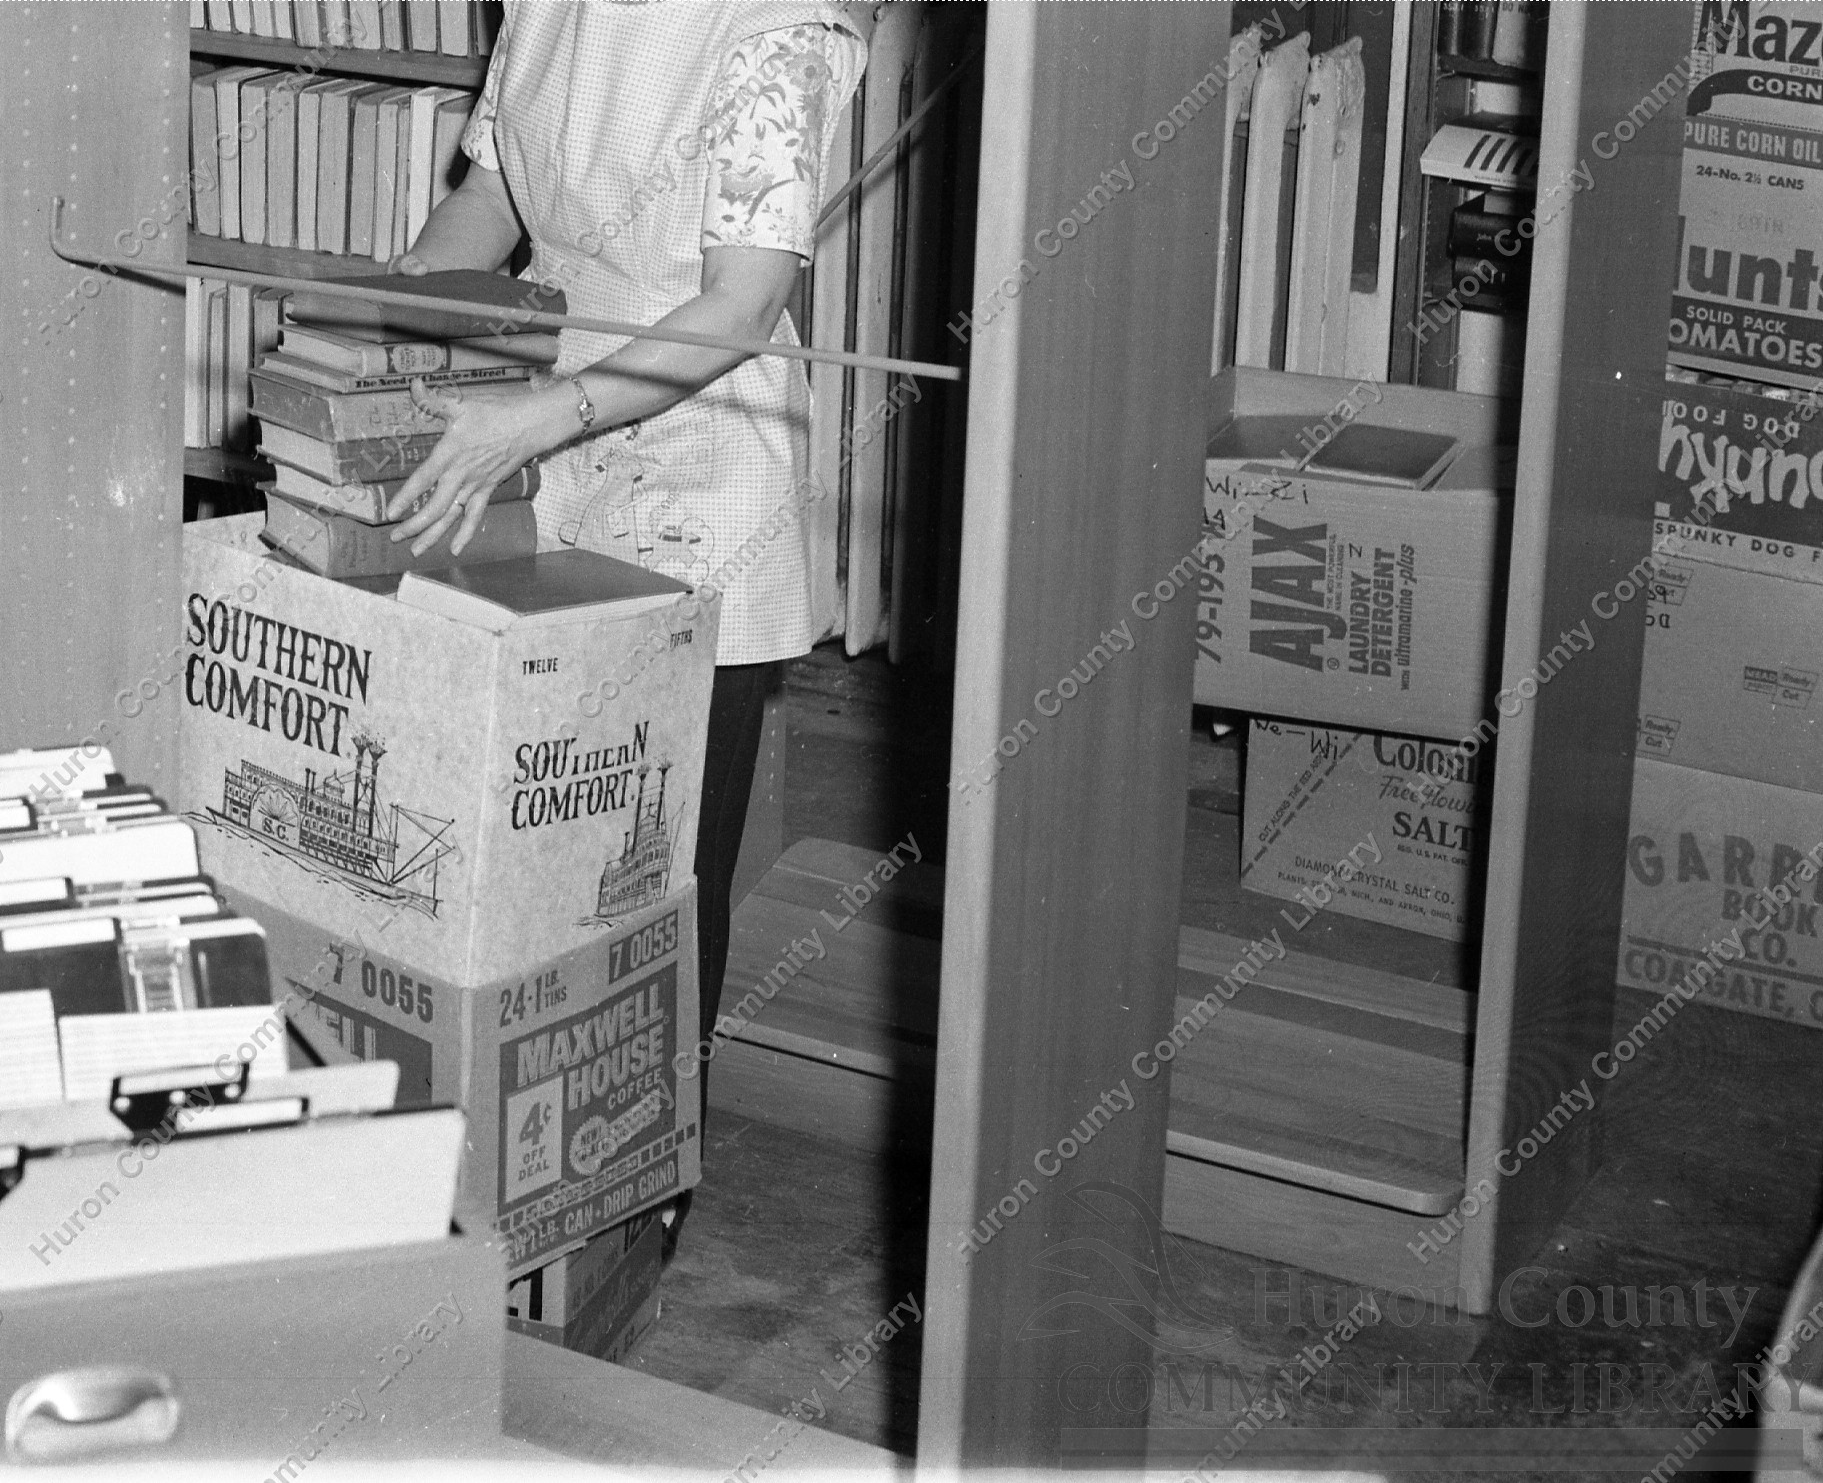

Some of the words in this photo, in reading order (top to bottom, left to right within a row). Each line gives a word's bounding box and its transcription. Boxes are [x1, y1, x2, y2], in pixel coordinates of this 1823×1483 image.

[1747, 75, 1823, 101] CORN
[1684, 121, 1730, 149] PURE
[1736, 129, 1787, 158] CORN
[1792, 138, 1822, 164] OIL
[1696, 164, 1742, 182] 24-No.
[1768, 175, 1805, 191] CANS
[1686, 304, 1735, 325] SOLID
[1743, 315, 1788, 335] PACK
[1654, 521, 1737, 548] SPUNKY
[1751, 538, 1796, 560] DOG
[1249, 514, 1348, 673] AJAX
[1371, 547, 1395, 678] DETERGENT
[1348, 570, 1372, 675] LAUNDRY
[186, 592, 373, 706] SOUTHERN
[522, 657, 559, 675] TWELVE
[185, 652, 350, 757] COMFORT
[262, 817, 289, 841] S.C.
[1392, 810, 1475, 852] SALT
[1628, 831, 1823, 905] GARR
[1404, 882, 1431, 899] SALT
[1434, 889, 1455, 906] CO.
[629, 913, 678, 969] 0055
[1744, 926, 1798, 968] CO.
[361, 960, 434, 1024] 0055
[545, 985, 567, 1009] TINS
[517, 982, 665, 1089] MAXWELL
[568, 1021, 663, 1112] HOUSE
[608, 1067, 663, 1110] COFFEE
[518, 1160, 550, 1182] DEAL
[523, 1146, 546, 1165] OFF
[565, 1203, 594, 1236] CAN
[604, 1183, 634, 1219] DRIP
[638, 1159, 676, 1200] GRIND
